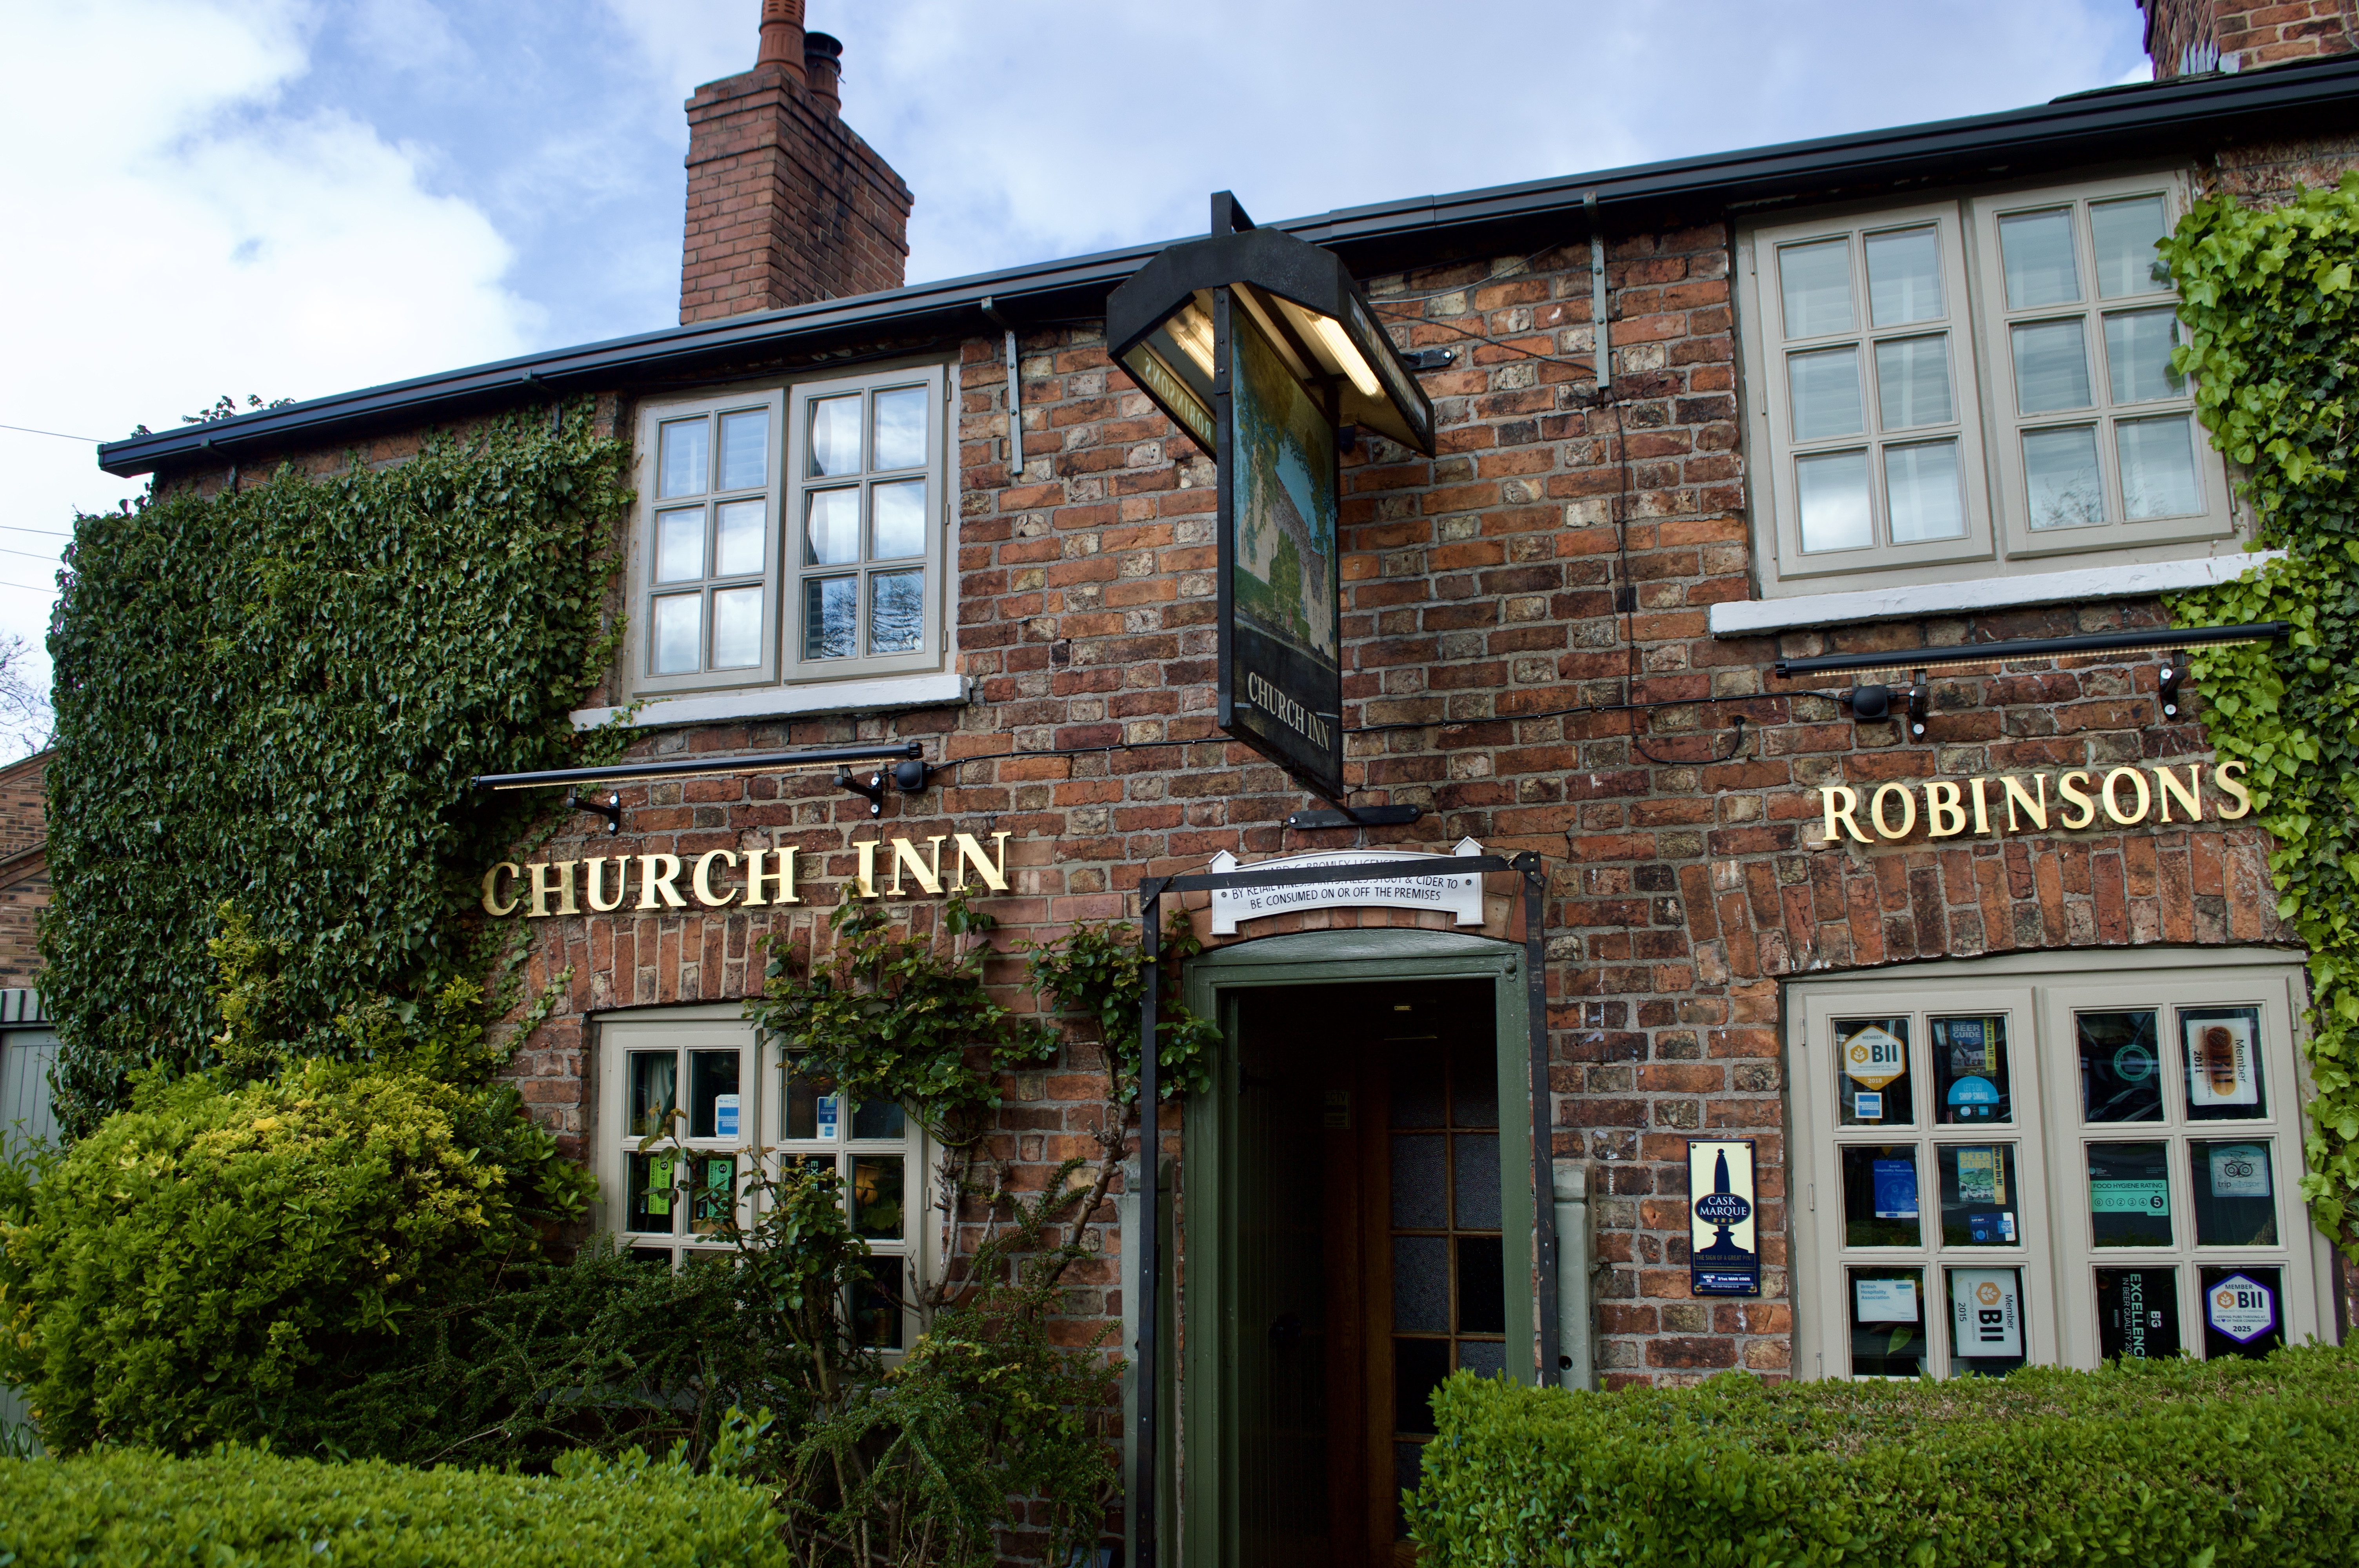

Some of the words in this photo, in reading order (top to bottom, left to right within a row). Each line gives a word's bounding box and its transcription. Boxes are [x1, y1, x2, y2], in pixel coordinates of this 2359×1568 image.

[1248, 672, 1305, 735] CHURCH
[1308, 712, 1329, 751] INN
[1819, 760, 2251, 843] ROBINSONS
[482, 846, 800, 917] CHURCH
[852, 831, 1012, 898] INN
[1232, 887, 1243, 900] BY
[1416, 876, 1444, 887] CIDER
[1447, 879, 1458, 889] TO
[1250, 898, 1262, 909] BE
[1267, 890, 1318, 906] CONSUMED
[1321, 888, 1334, 898] ON
[1338, 888, 1350, 897] OR
[1354, 887, 1370, 897] OFF
[1374, 887, 1392, 897] THE
[1395, 887, 1441, 900] PREMISES
[1986, 1018, 1993, 1028] We
[1872, 1044, 1897, 1062] BII
[2194, 1051, 2203, 1074] 2011
[2235, 1040, 2246, 1082] Member
[1959, 1092, 1972, 1100] SHOP
[1973, 1091, 1989, 1100] SMALL
[1963, 1083, 1975, 1092] LET'S
[1959, 1152, 1991, 1161] BEER
[1994, 1146, 2001, 1157] We
[1708, 1196, 1736, 1205] CASK
[2153, 1197, 2161, 1207] 5
[1700, 1207, 1747, 1217] MARQUE
[2237, 1291, 2263, 1308] BII
[1958, 1302, 1967, 1321] 2015
[2005, 1294, 2014, 1329] Member
[1979, 1310, 2004, 1341] BII
[2123, 1308, 2132, 1341] QUALITY
